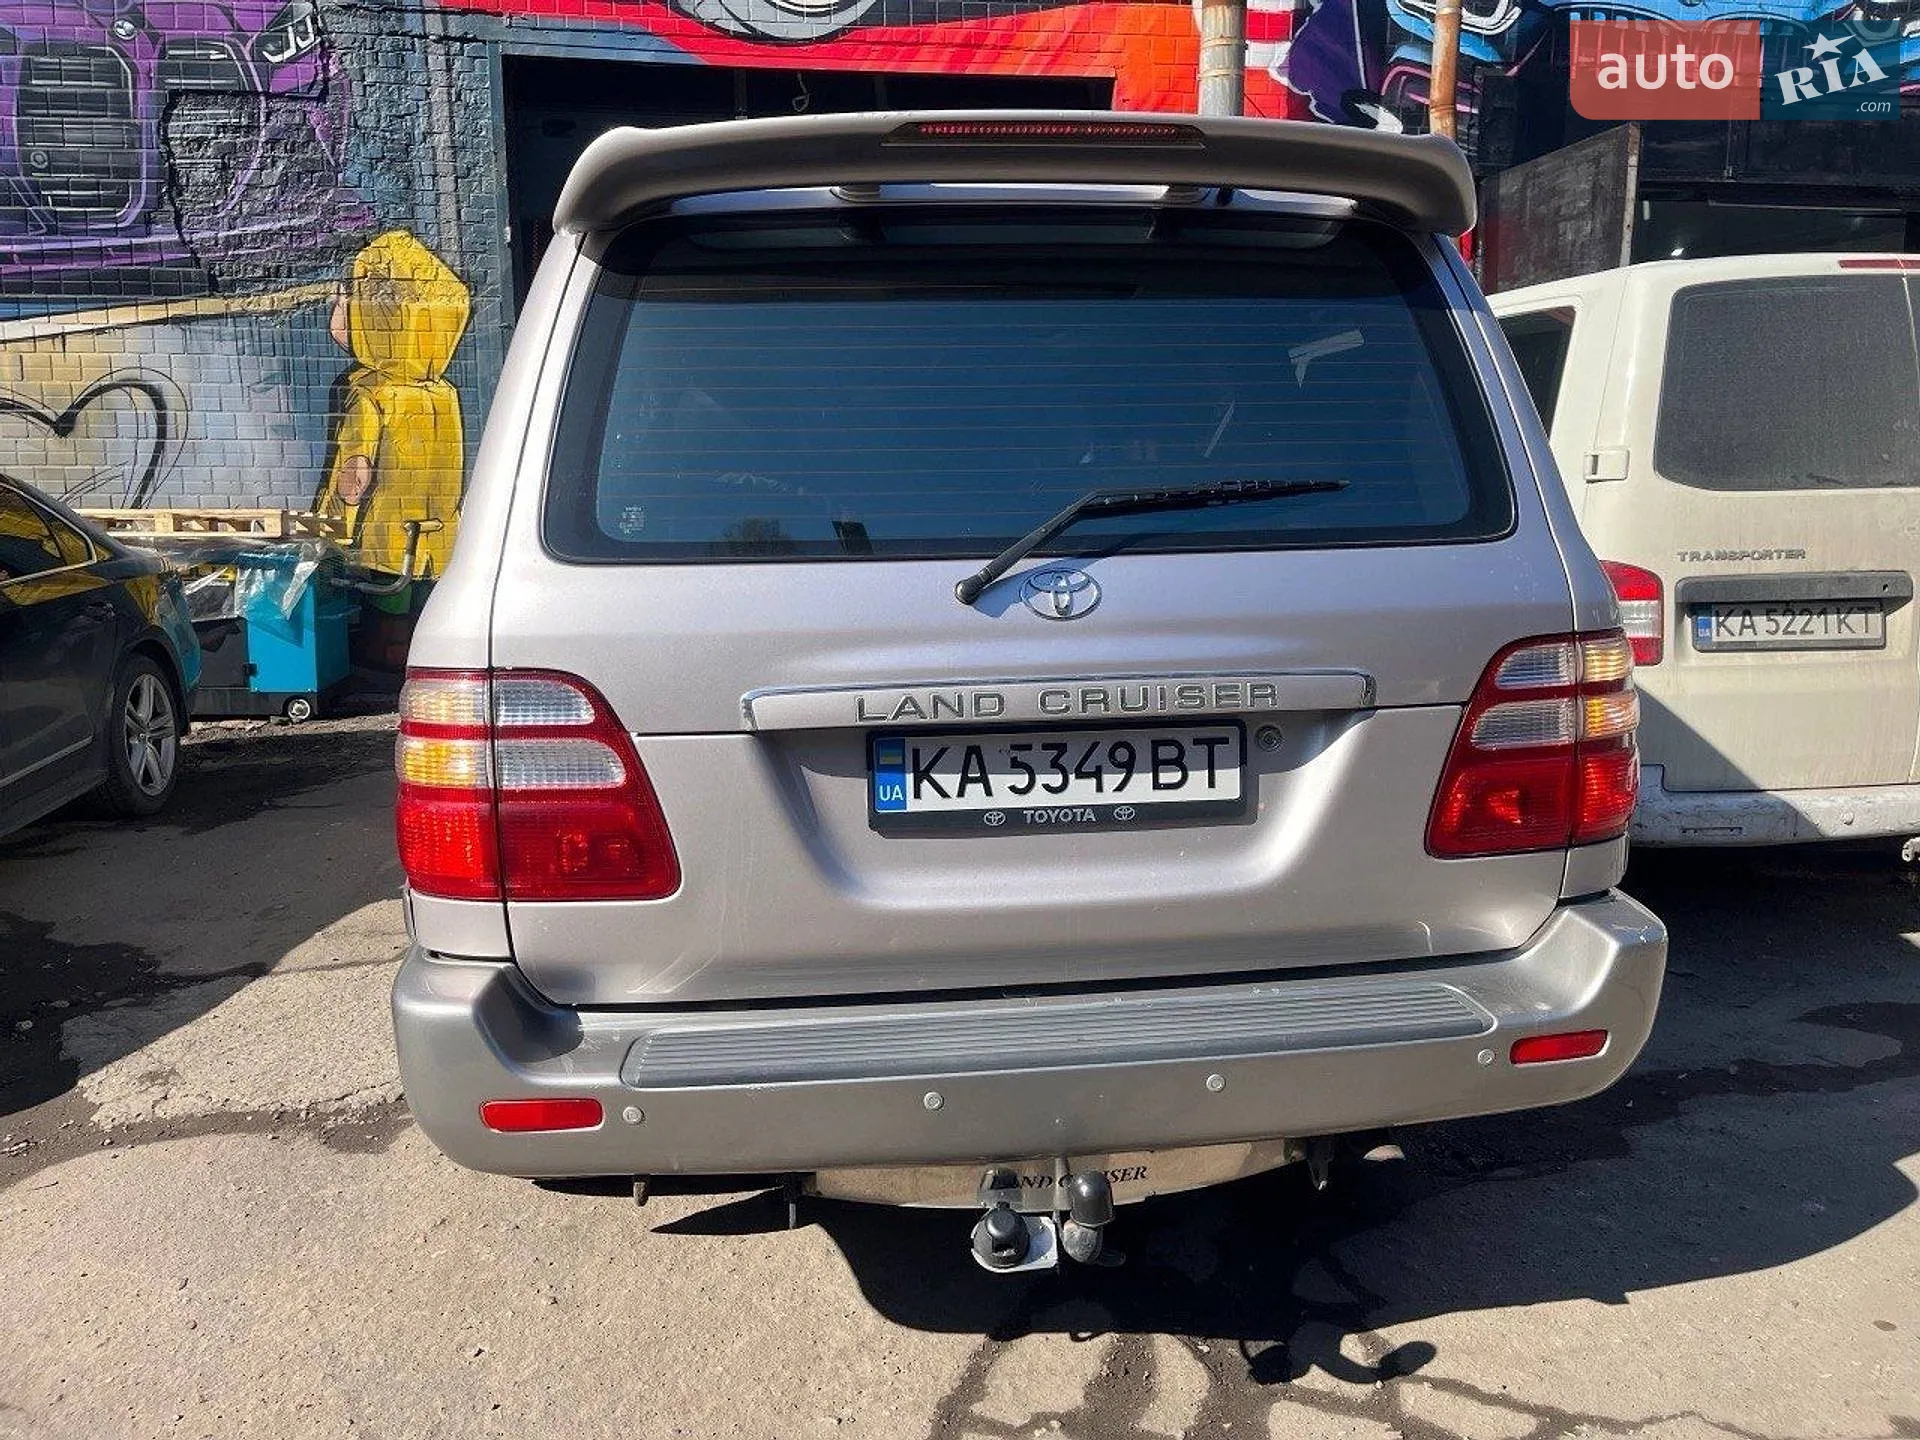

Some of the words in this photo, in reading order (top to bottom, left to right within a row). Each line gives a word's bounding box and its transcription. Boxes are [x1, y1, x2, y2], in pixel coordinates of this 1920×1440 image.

[1677, 549, 1807, 562] TRANSPORTER
[1714, 608, 1759, 637] KA
[1765, 607, 1830, 635] 5221
[1838, 605, 1877, 634] KT
[855, 690, 1006, 724] LAND
[1038, 682, 1279, 716] CRUISER
[911, 744, 994, 800] KA
[1007, 740, 1138, 796] 5349
[1151, 736, 1231, 791] BT
[879, 785, 904, 802] UA
[1022, 807, 1097, 824] TOYOTA
